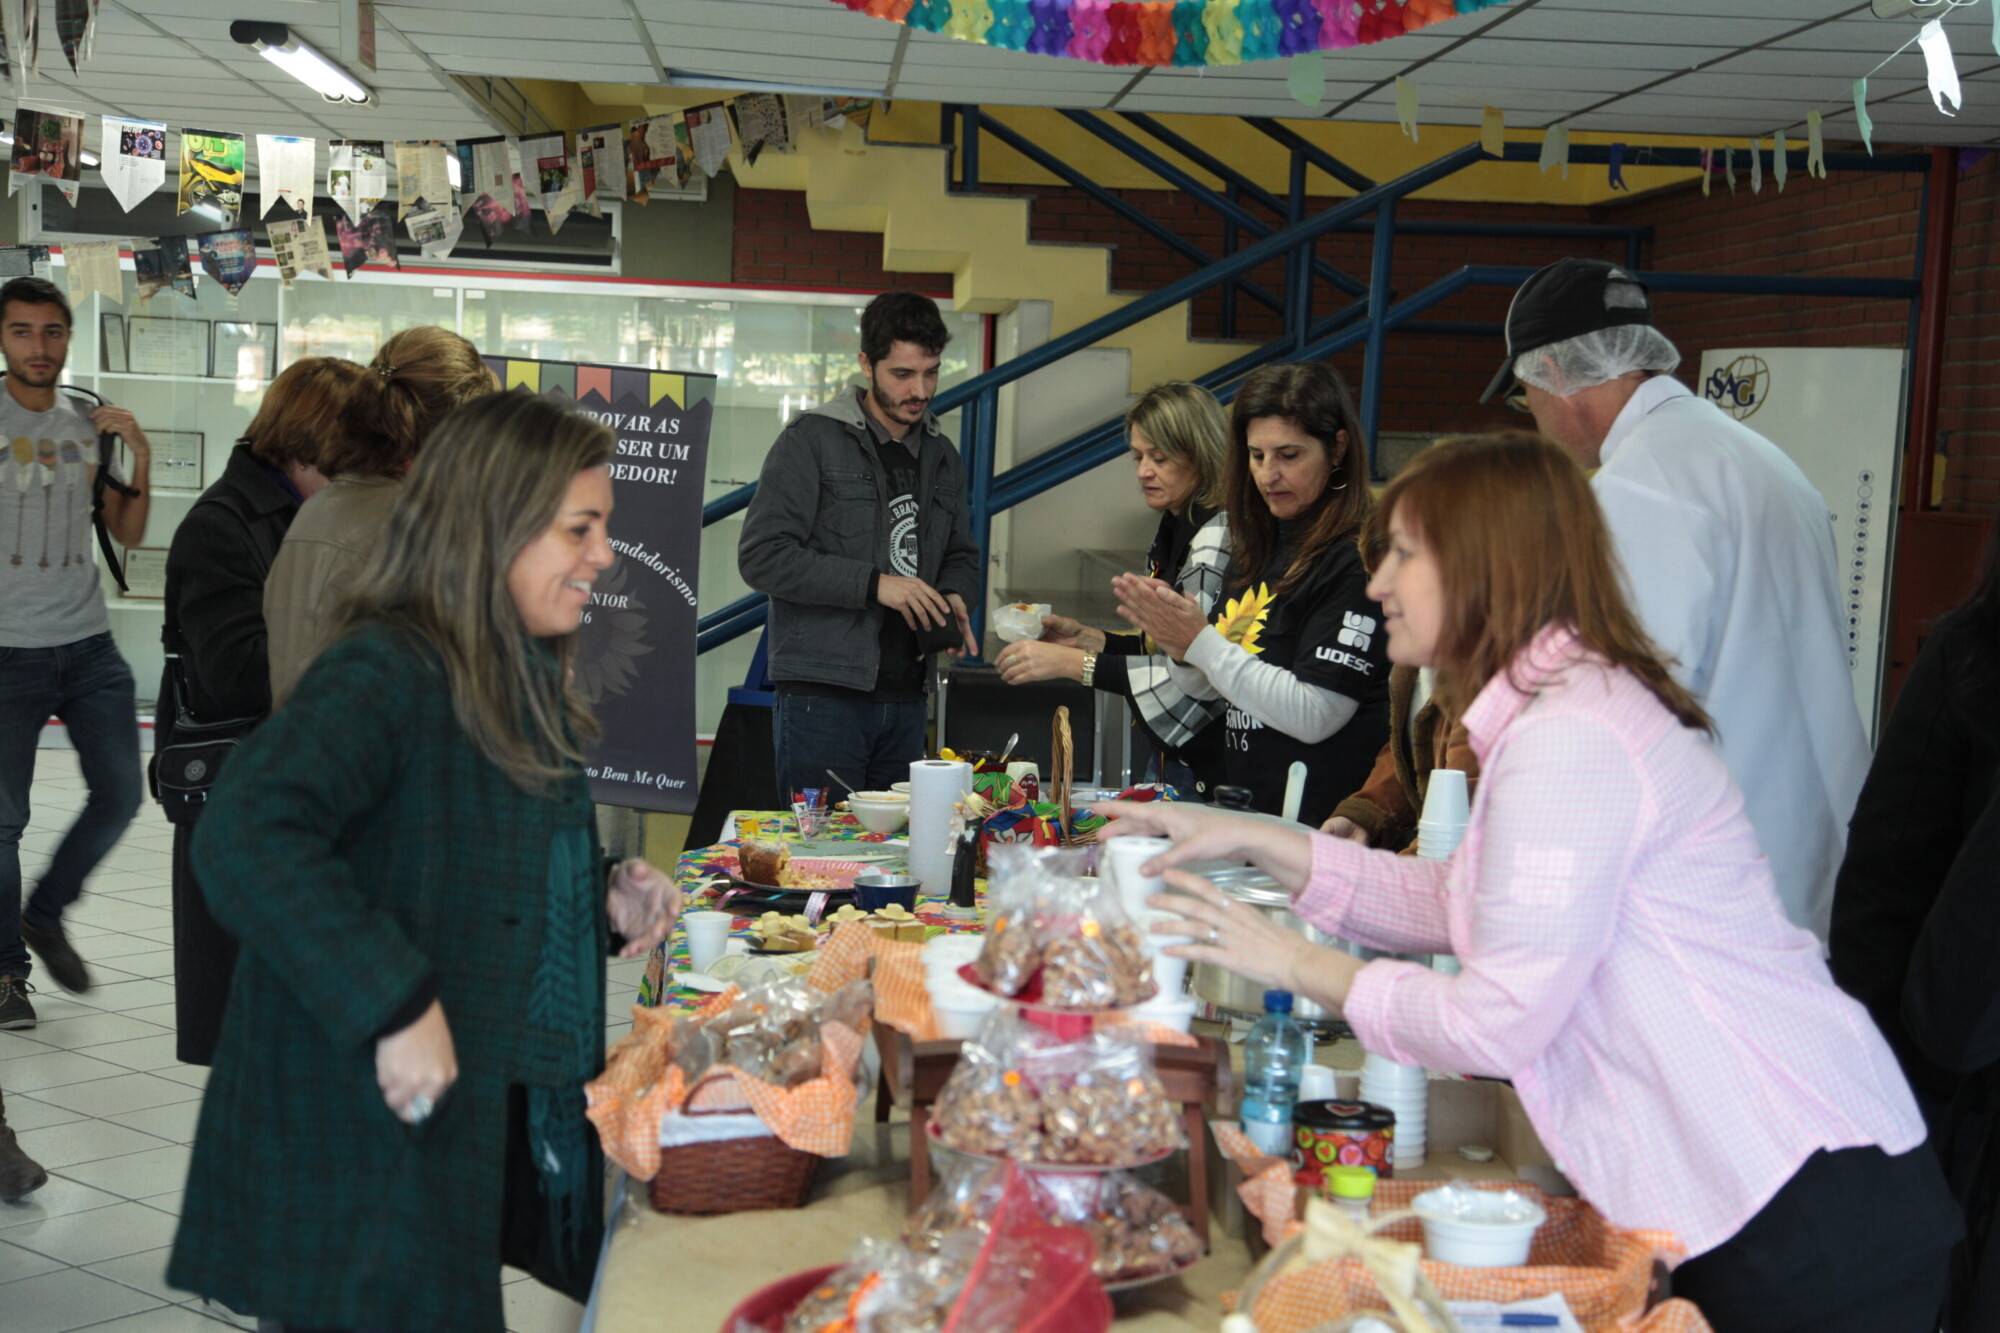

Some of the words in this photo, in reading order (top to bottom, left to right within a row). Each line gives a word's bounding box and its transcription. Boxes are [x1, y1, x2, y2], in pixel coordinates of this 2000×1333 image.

[654, 418, 680, 435] AS
[616, 439, 653, 458] SER
[658, 443, 690, 461] UM
[1315, 646, 1374, 676] UDESC
[601, 766, 629, 783] Bem
[631, 770, 653, 785] Me
[656, 773, 686, 790] Quer
